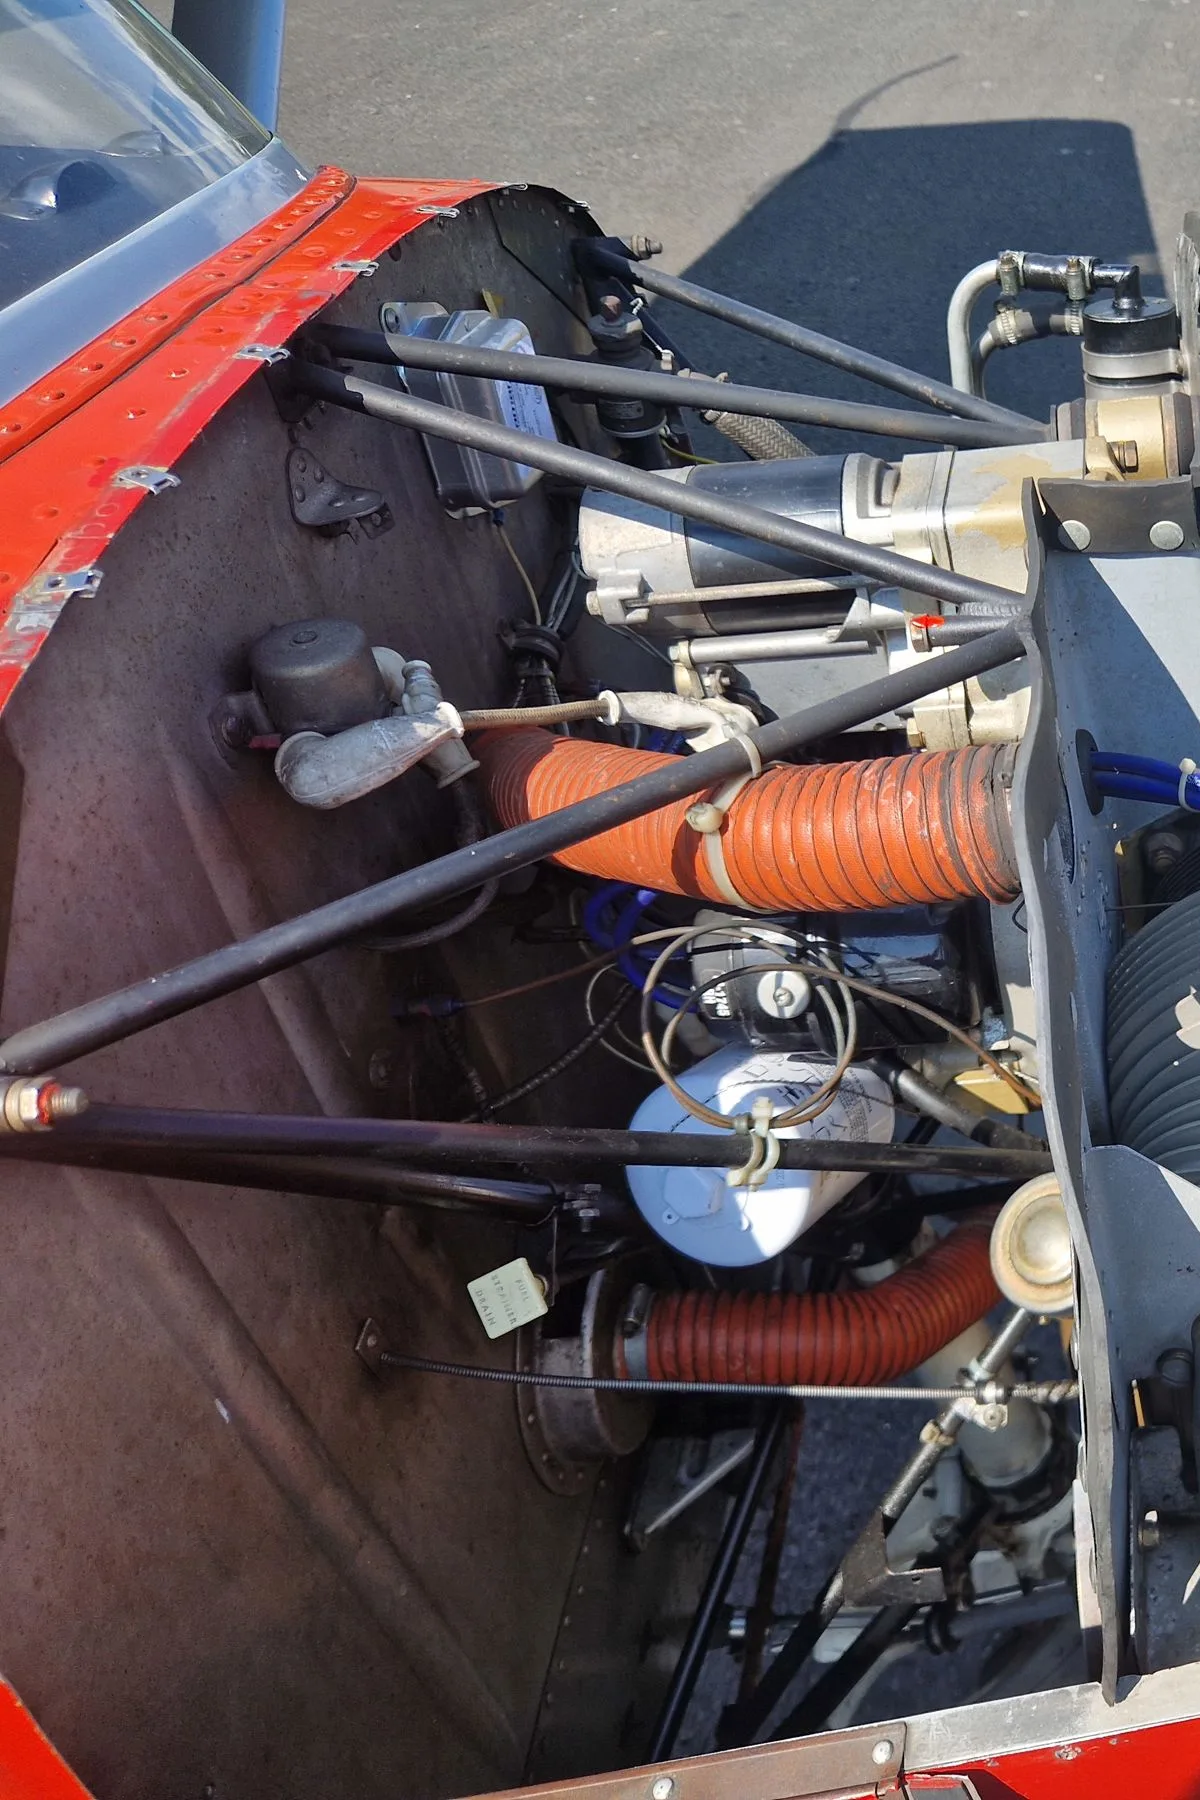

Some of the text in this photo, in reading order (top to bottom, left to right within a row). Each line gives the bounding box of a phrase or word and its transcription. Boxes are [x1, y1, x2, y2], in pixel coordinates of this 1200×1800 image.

[475, 1289, 497, 1326] DRAIN
[491, 1274, 518, 1325] STRAINER
[515, 1279, 529, 1302] FUEL
